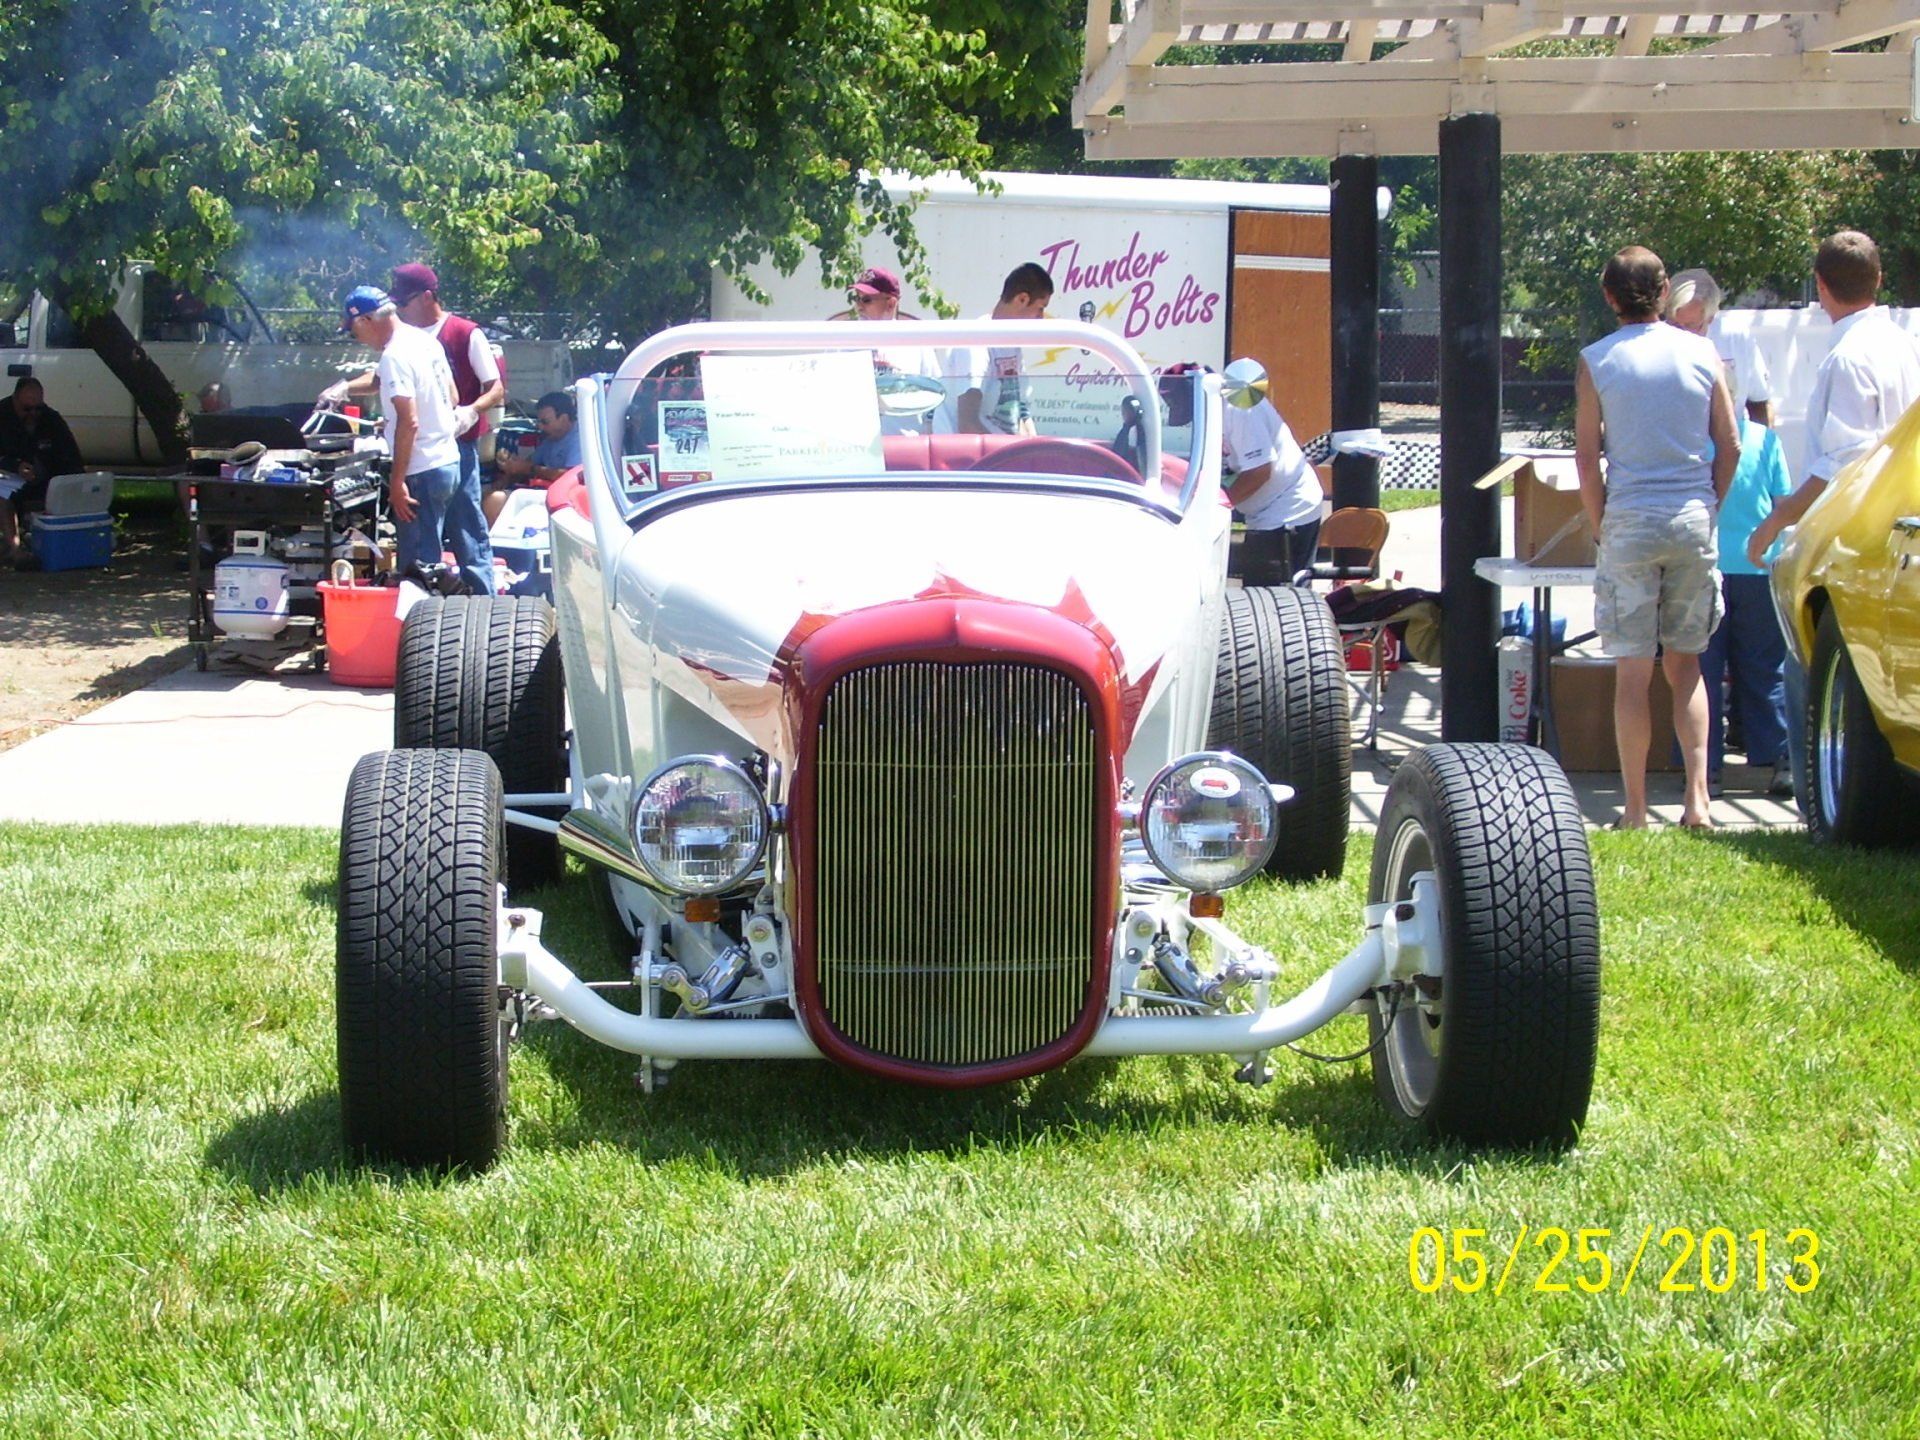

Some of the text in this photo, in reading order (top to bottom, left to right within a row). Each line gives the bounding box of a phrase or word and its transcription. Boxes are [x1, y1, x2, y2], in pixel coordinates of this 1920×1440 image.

[1039, 231, 1168, 293] Thunder
[1124, 274, 1220, 338] Bolts
[676, 436, 700, 454] 247
[1509, 670, 1528, 719] Coke
